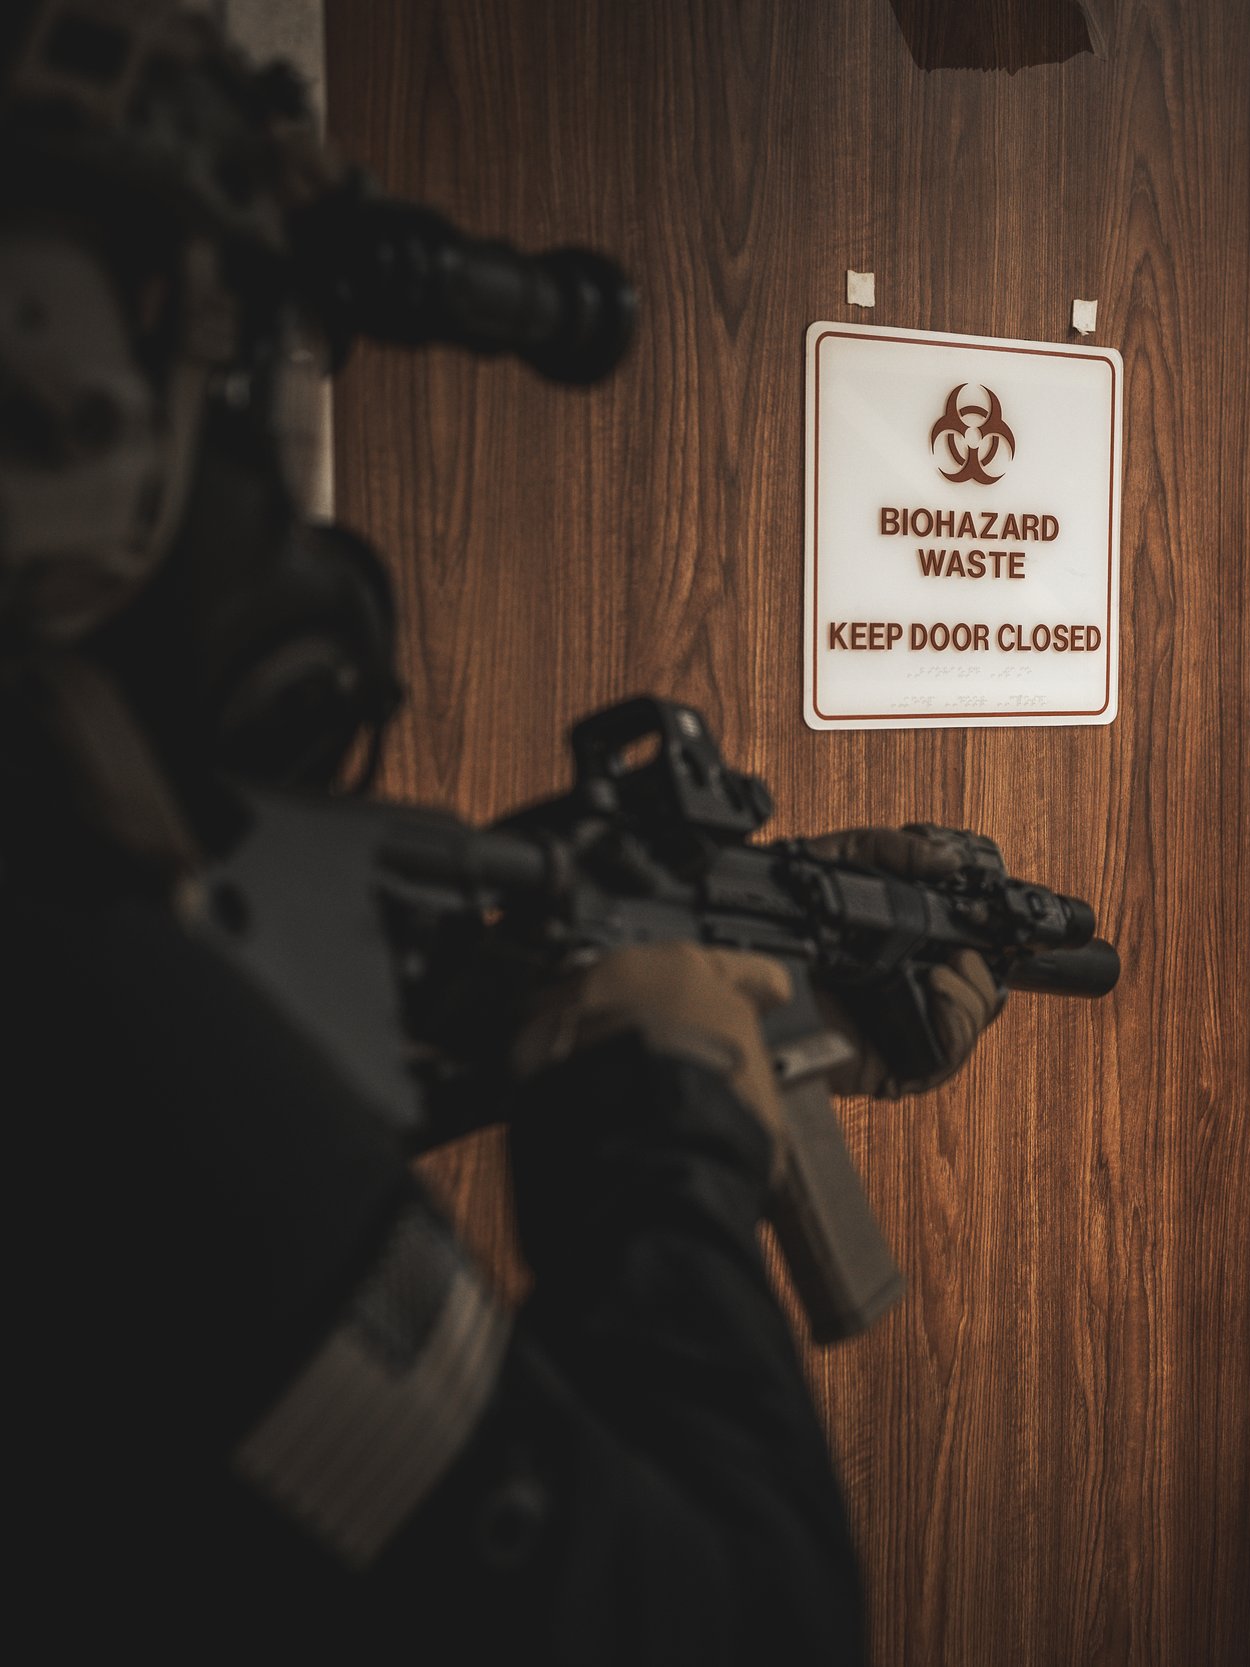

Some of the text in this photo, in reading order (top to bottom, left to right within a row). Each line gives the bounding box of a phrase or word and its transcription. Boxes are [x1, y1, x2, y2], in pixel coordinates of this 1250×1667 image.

[880, 507, 1060, 542] BIOHAZARD
[918, 549, 1026, 579] WASTE
[829, 622, 1101, 652] KEEP DOOR CLOSED
